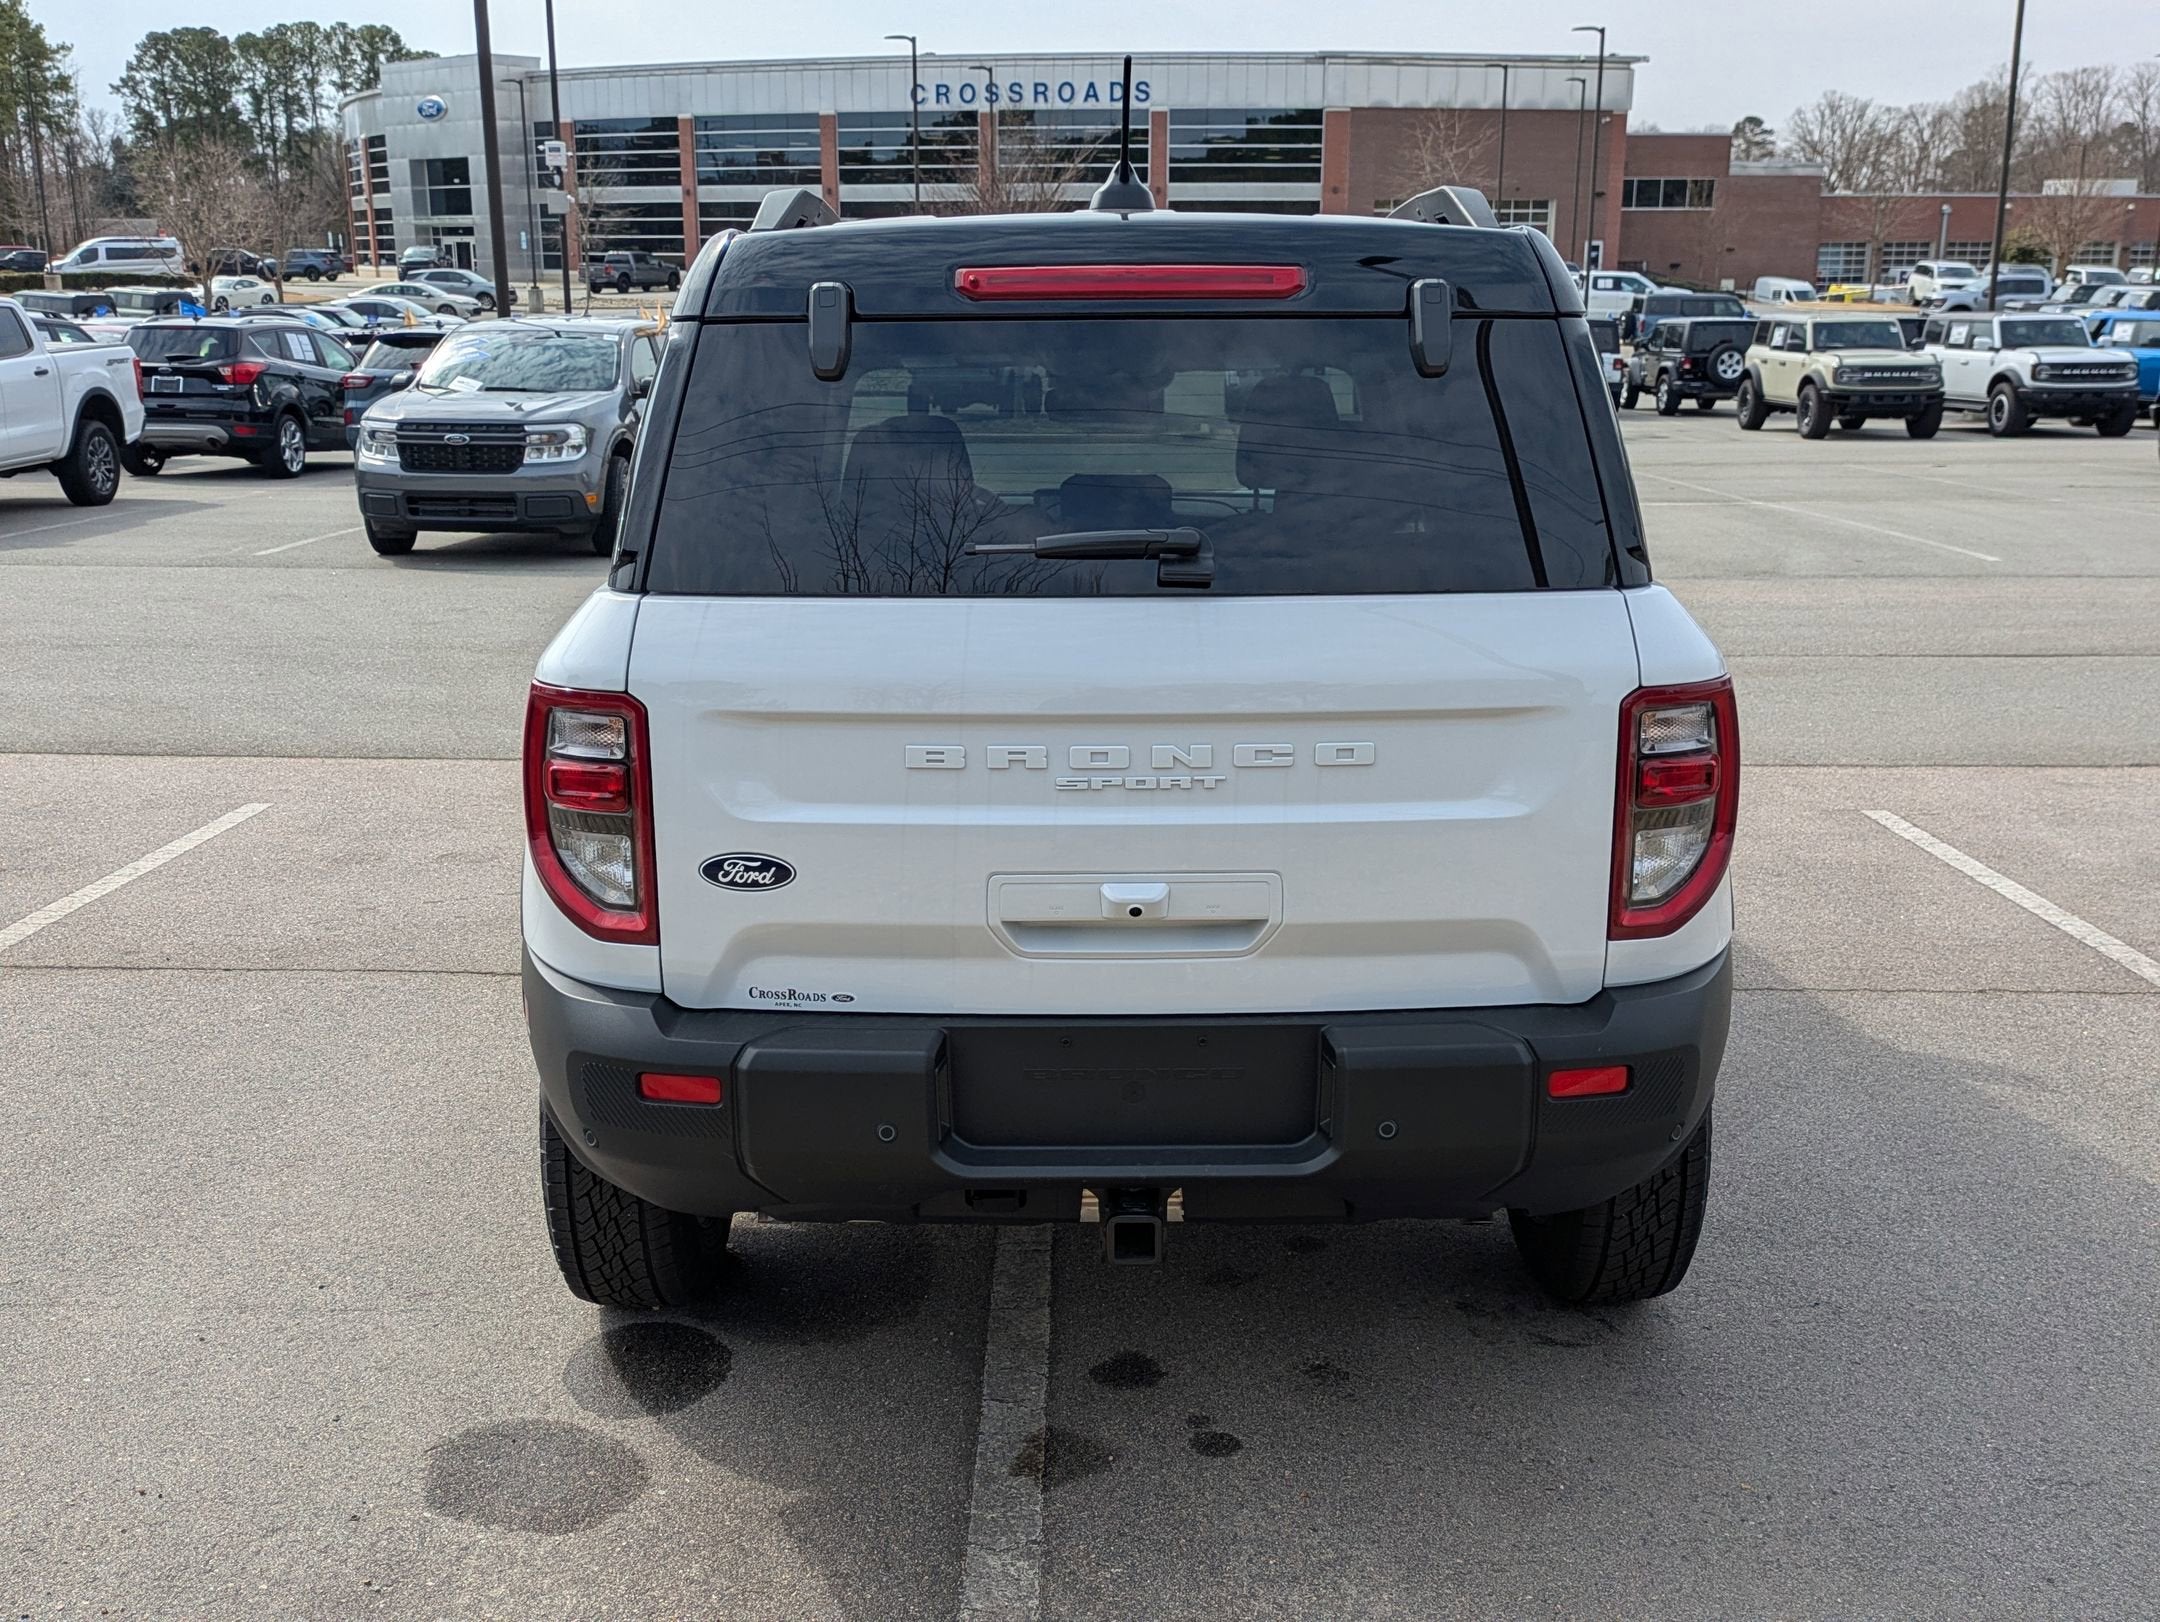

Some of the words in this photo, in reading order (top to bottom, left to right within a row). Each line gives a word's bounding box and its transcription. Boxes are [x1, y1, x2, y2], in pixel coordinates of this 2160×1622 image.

[910, 81, 1151, 105] CROSSROADS
[904, 742, 1377, 770] BRONCO
[1054, 775, 1227, 791] SPORT
[717, 858, 777, 885] Ford
